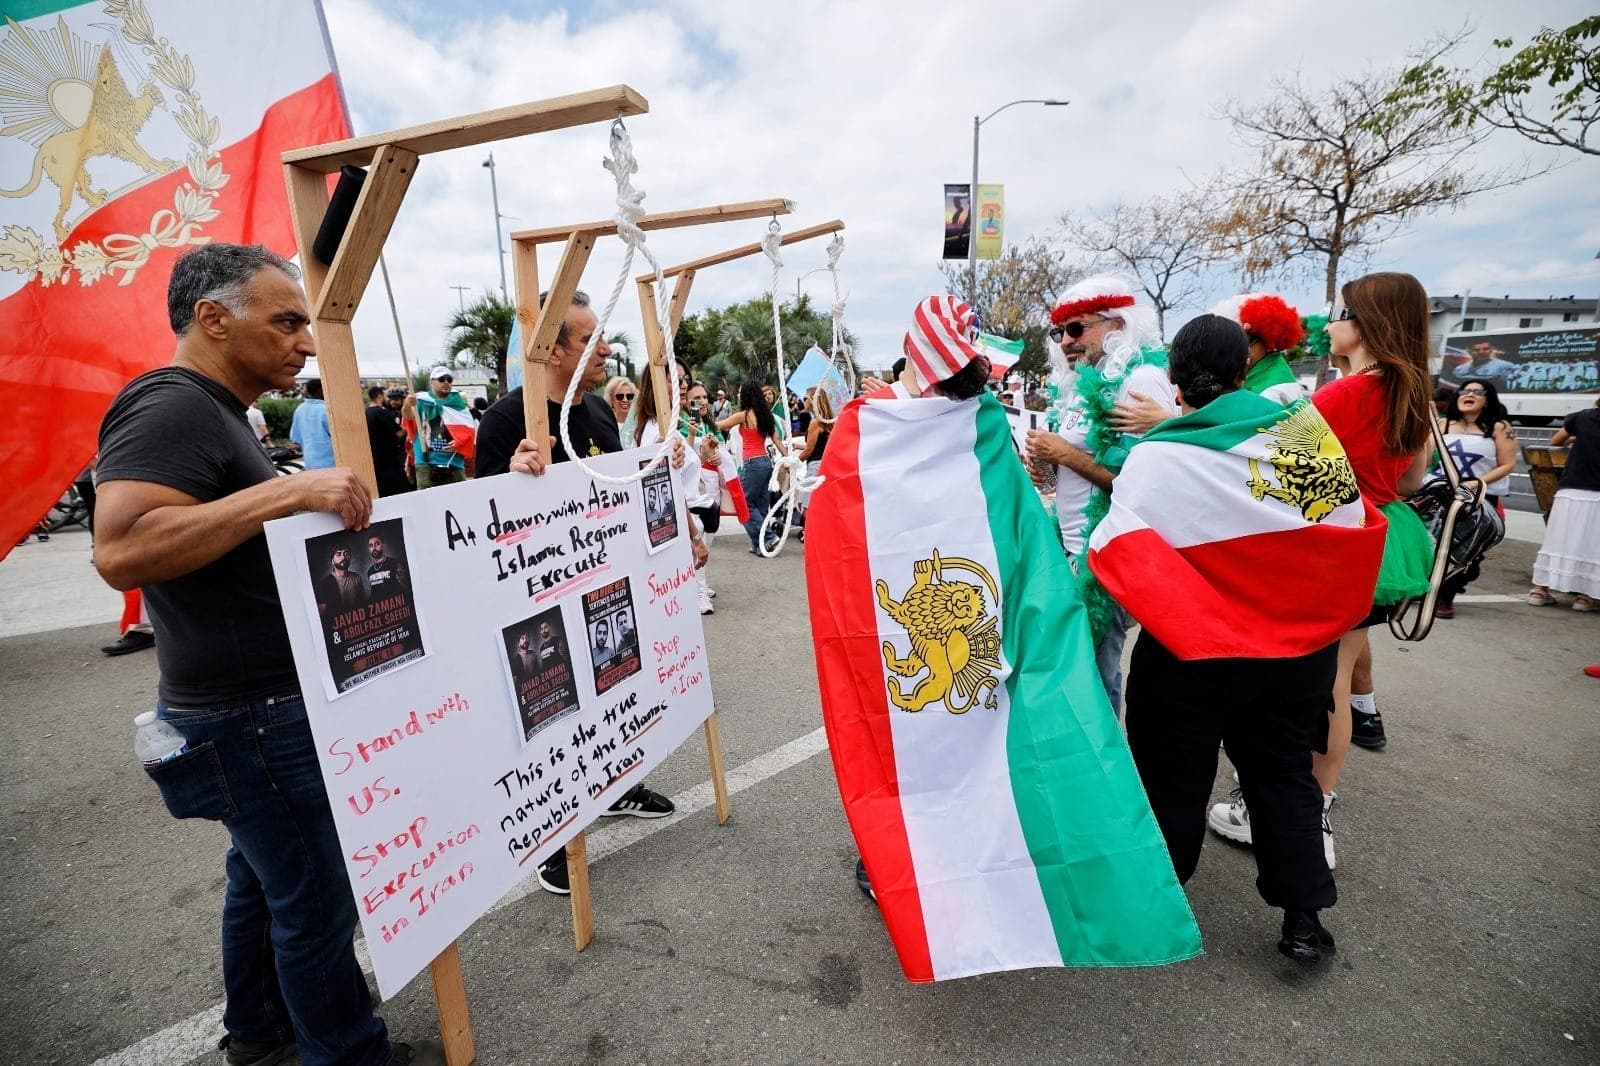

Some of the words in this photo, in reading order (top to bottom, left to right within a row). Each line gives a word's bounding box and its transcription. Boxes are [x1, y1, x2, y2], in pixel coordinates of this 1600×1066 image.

[445, 510, 476, 551] At
[551, 499, 585, 519] with
[588, 479, 630, 513] Azan
[491, 544, 566, 582] Islamic
[569, 522, 629, 553] Regime
[526, 551, 607, 598] Execute
[332, 608, 366, 630] JAVAD
[368, 594, 405, 617] ZAMANI
[648, 567, 681, 605] Stand
[333, 631, 342, 645] &
[344, 617, 384, 640] ABOLFAZL
[385, 606, 411, 625] SAEEDI
[344, 646, 367, 662] ISLAMIC
[653, 635, 680, 663] Stop
[657, 645, 701, 685] Execution
[679, 671, 703, 694] Iran
[328, 710, 424, 776] Stand
[426, 693, 471, 725] with
[494, 762, 543, 798] This
[549, 746, 565, 767] is
[571, 723, 598, 749] the
[602, 692, 638, 726] true
[500, 777, 564, 833] nature
[571, 755, 588, 782] of
[592, 737, 617, 765] the
[618, 699, 669, 744] Islamic
[508, 795, 580, 858] Republic
[586, 781, 602, 798] in
[602, 747, 645, 786] Iran
[352, 816, 428, 878] Stop
[363, 823, 481, 915] Execution
[381, 917, 410, 944] in
[409, 861, 474, 917] Iran
